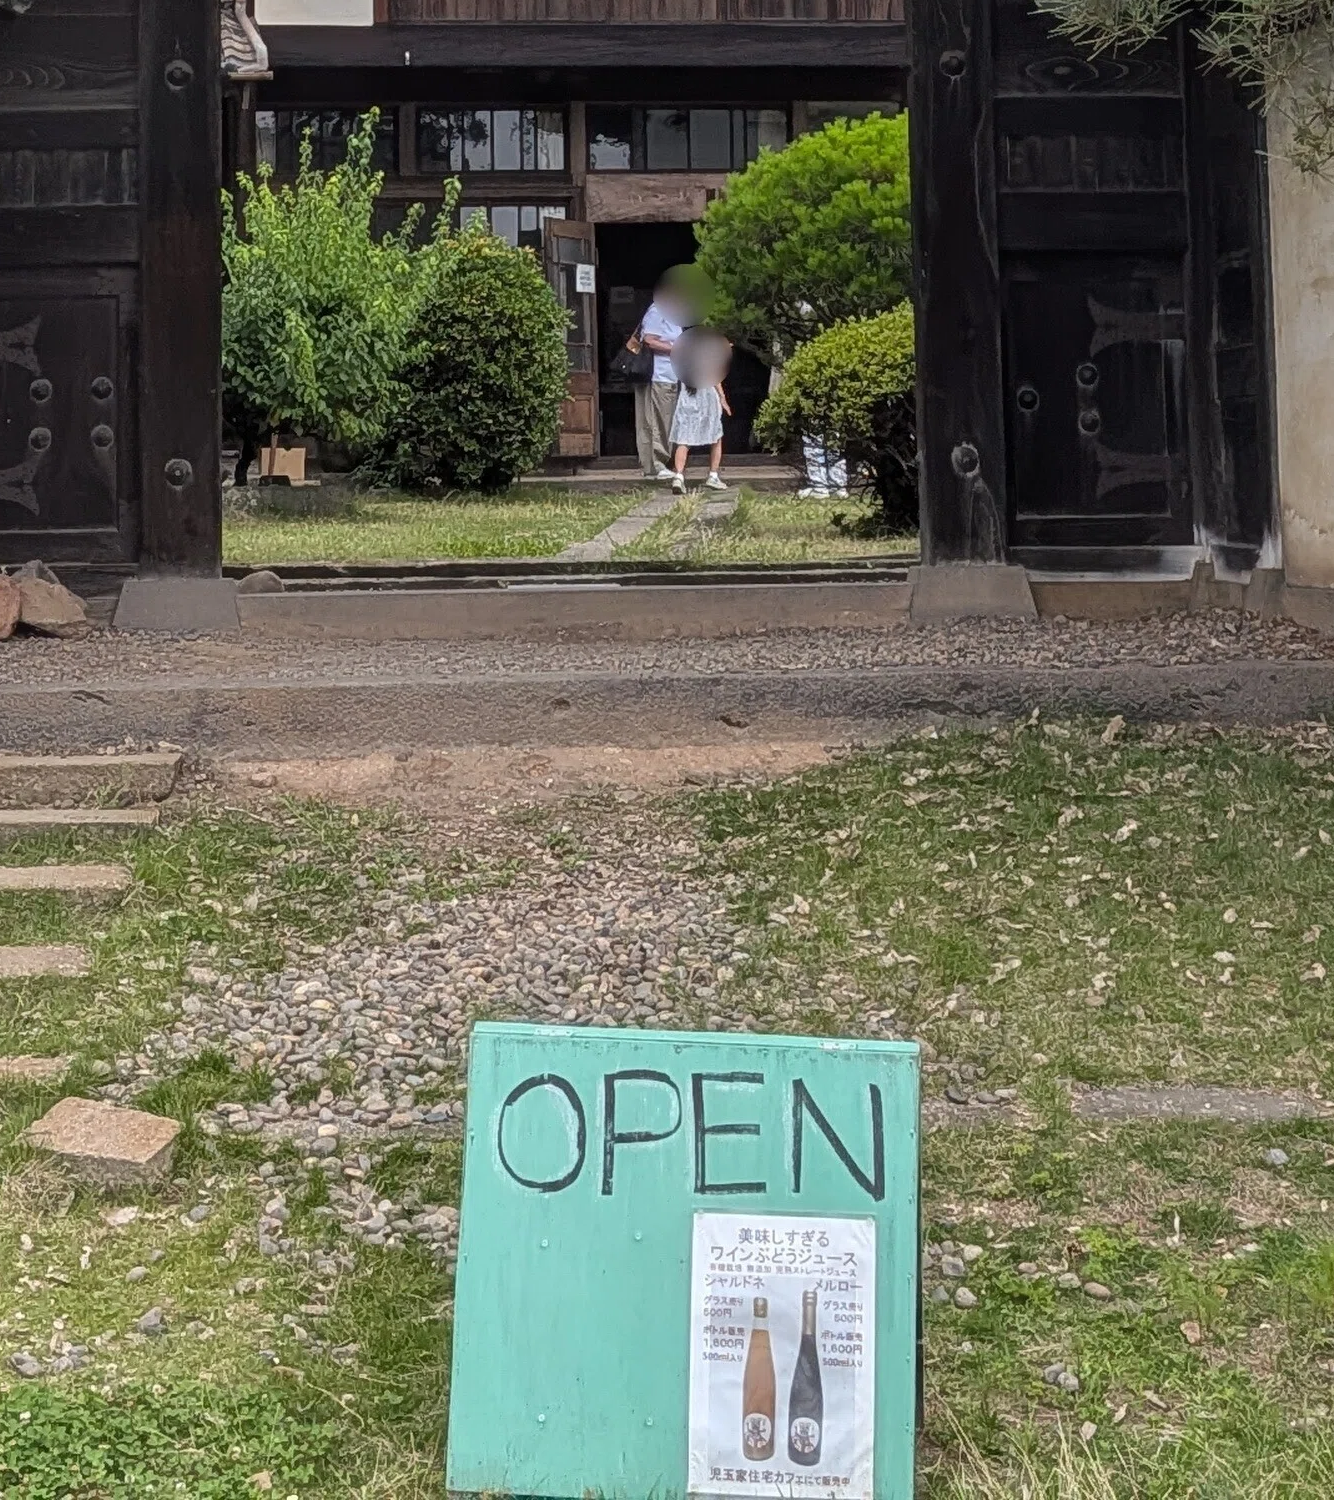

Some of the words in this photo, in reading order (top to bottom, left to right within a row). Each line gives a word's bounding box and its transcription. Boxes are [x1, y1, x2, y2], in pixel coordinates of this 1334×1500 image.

[497, 1069, 885, 1202] OPEN
[738, 1228, 830, 1247] 美味しすぎる
[710, 1245, 858, 1266] ワインぶどうジュース
[705, 1274, 765, 1288] シャルドネ
[815, 1279, 863, 1292] メルロー
[704, 1296, 744, 1307] グラス売り
[823, 1300, 863, 1311] グラス売り
[834, 1313, 863, 1324] 500円
